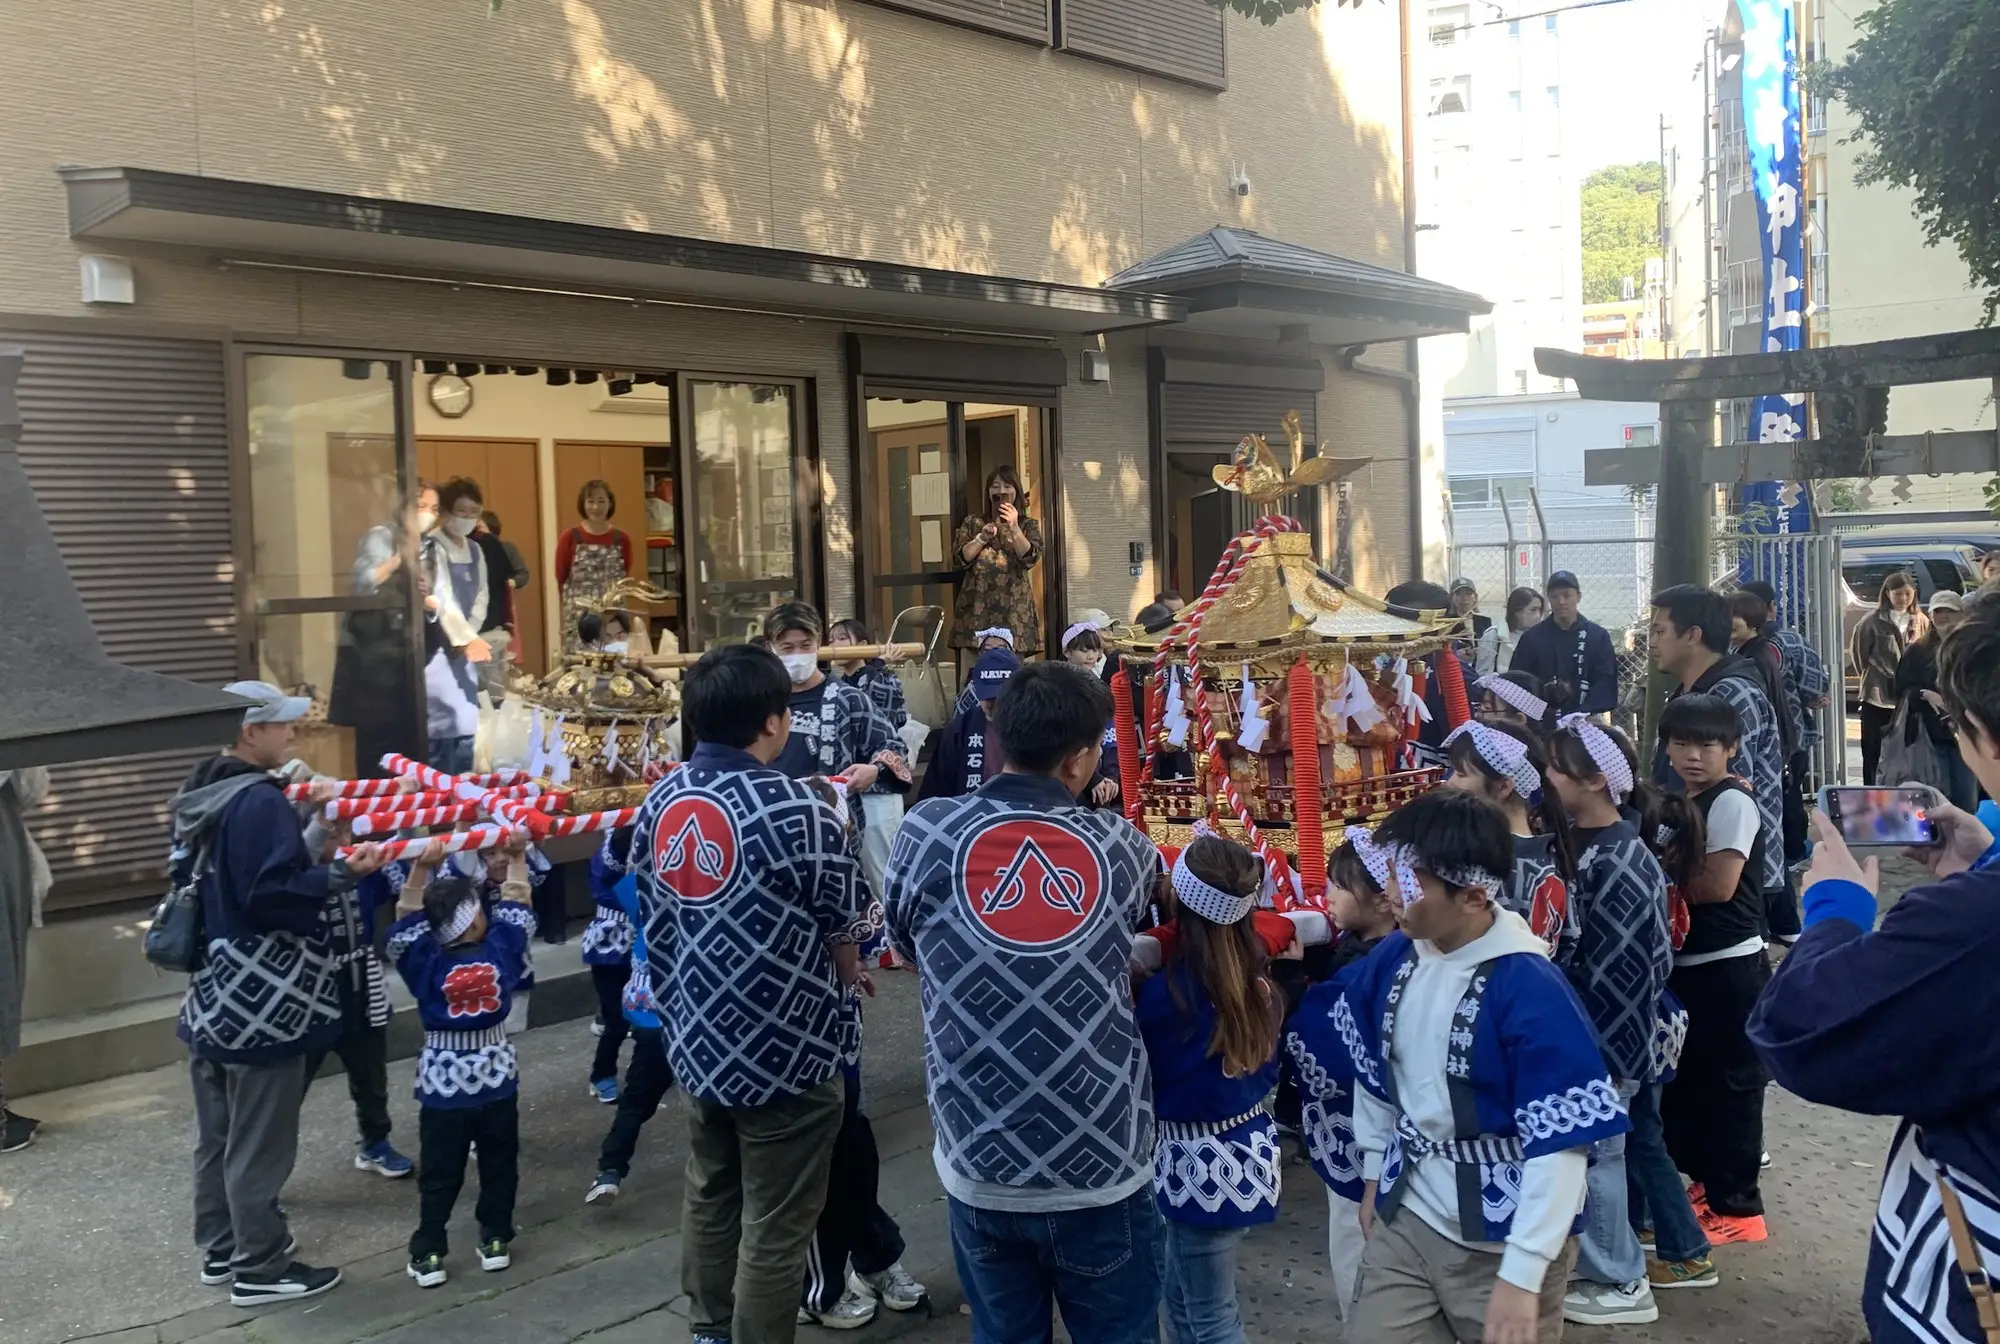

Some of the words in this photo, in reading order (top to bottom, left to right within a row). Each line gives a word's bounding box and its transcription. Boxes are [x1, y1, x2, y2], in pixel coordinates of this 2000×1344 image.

[980, 670, 1012, 679] NAVY
[966, 733, 984, 794] 本石灰
[440, 962, 501, 1018] 祭
